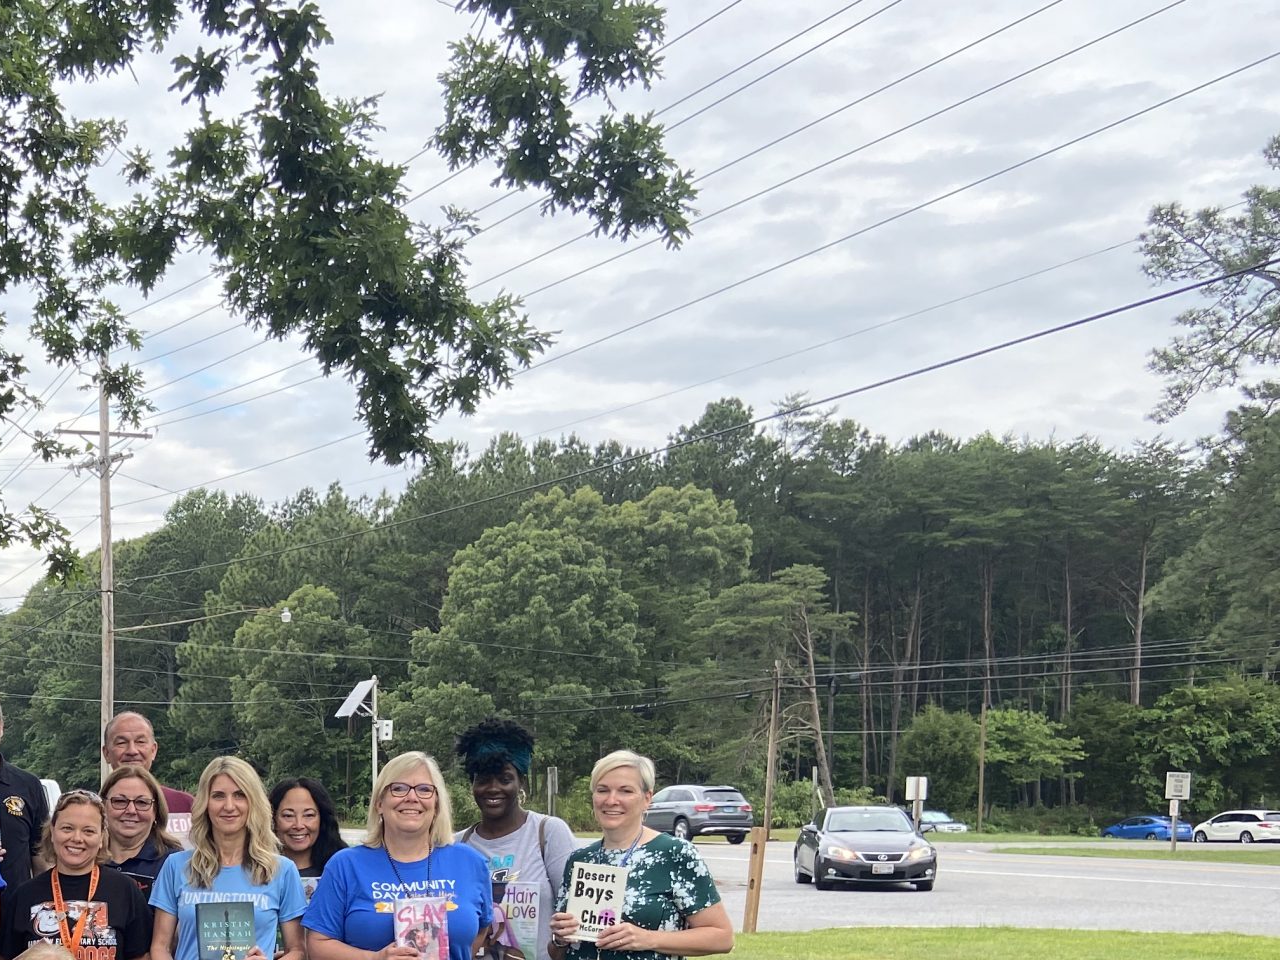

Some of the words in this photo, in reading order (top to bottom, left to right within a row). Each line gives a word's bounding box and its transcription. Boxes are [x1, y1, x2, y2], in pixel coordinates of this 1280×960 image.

[577, 868, 617, 884] Desert
[371, 879, 456, 892] COMMUNITY
[372, 891, 400, 900] DAY
[505, 886, 538, 905] Hair
[574, 881, 614, 905] Boys
[203, 921, 251, 929] KRISTIN
[581, 909, 616, 927] Chris
[203, 930, 252, 938] HANNAH
